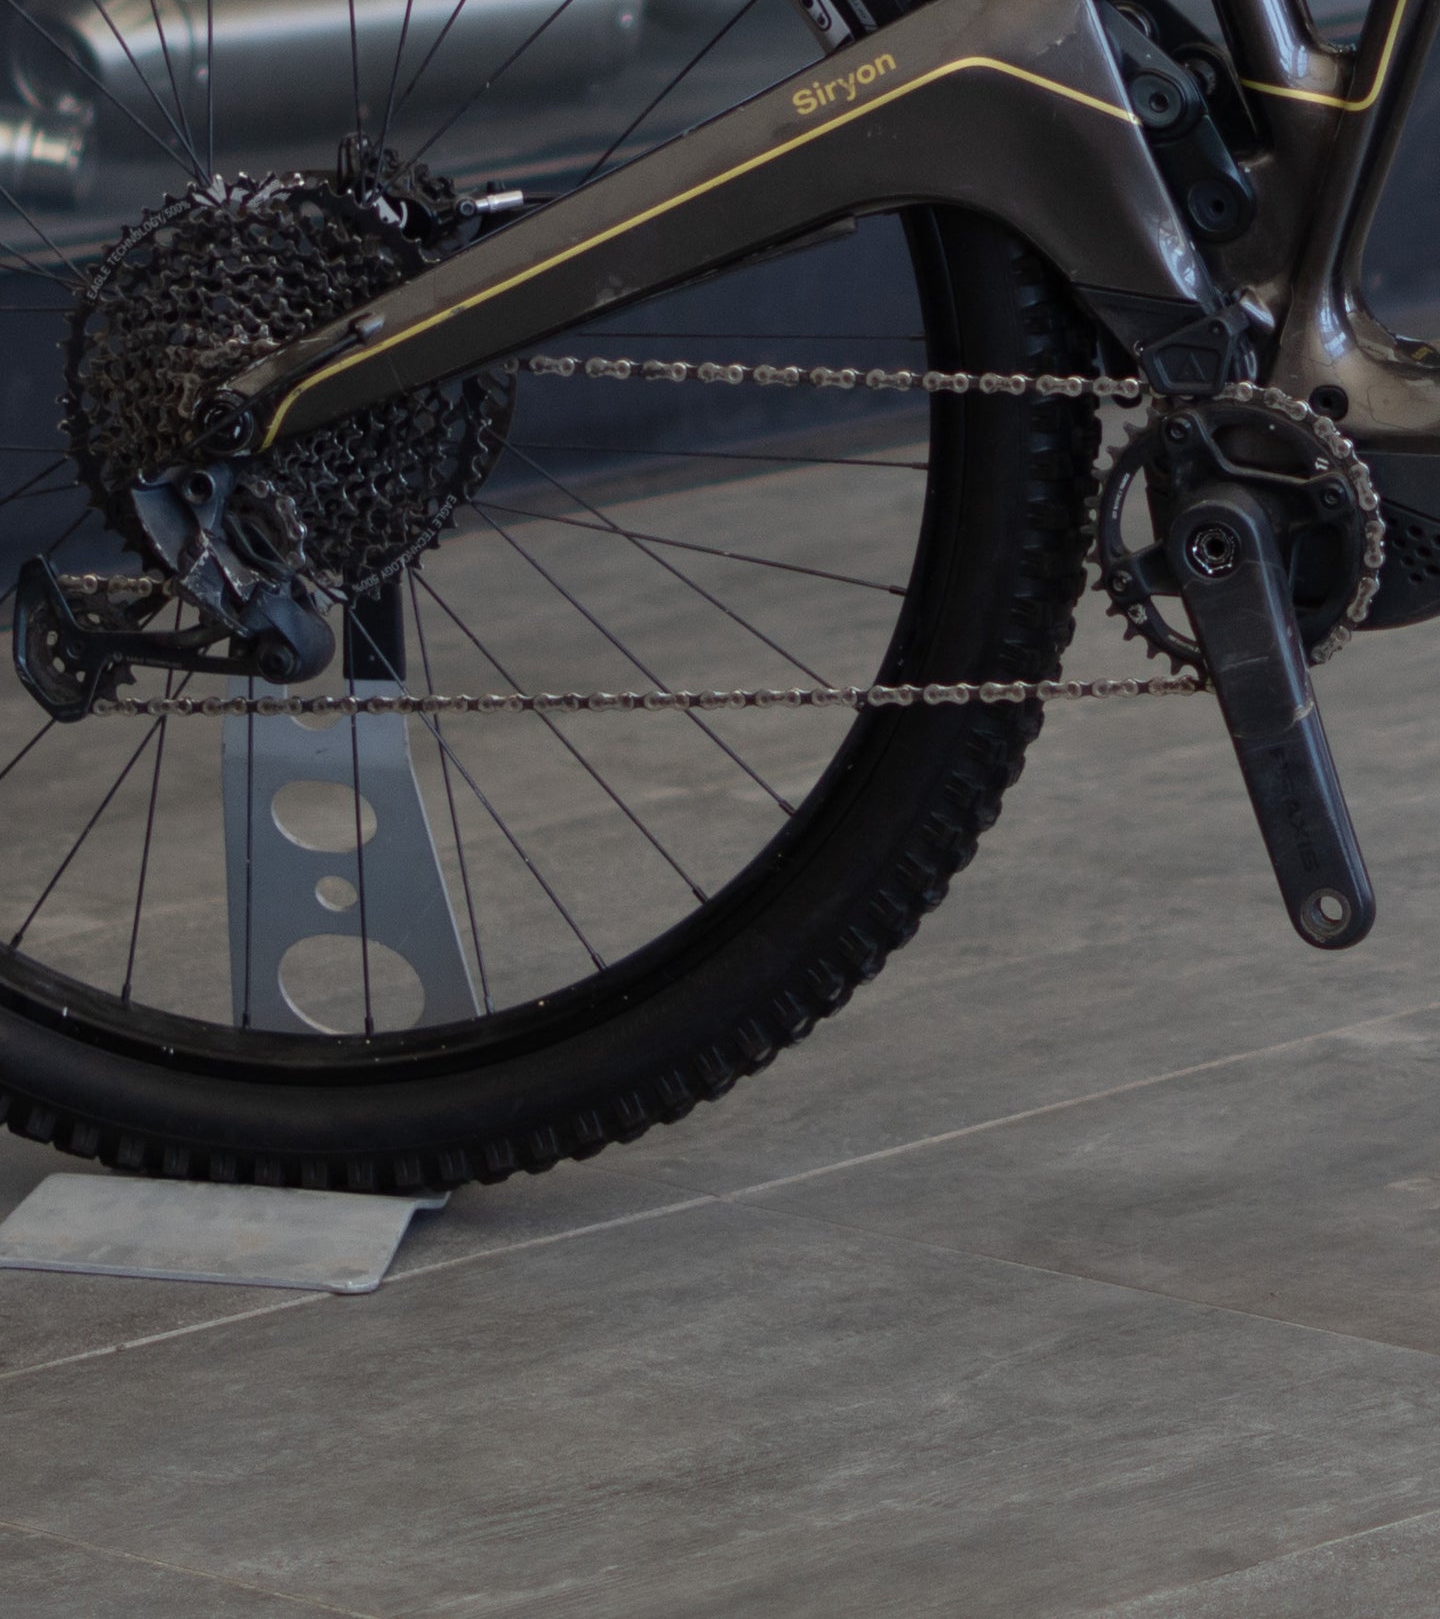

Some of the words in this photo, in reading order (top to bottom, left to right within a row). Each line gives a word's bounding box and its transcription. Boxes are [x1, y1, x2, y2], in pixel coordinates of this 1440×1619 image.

[791, 51, 897, 115] Siryon
[86, 266, 111, 300] EAGLE
[107, 212, 163, 265] TECHNOLOGY
[432, 494, 457, 528] EAGLE
